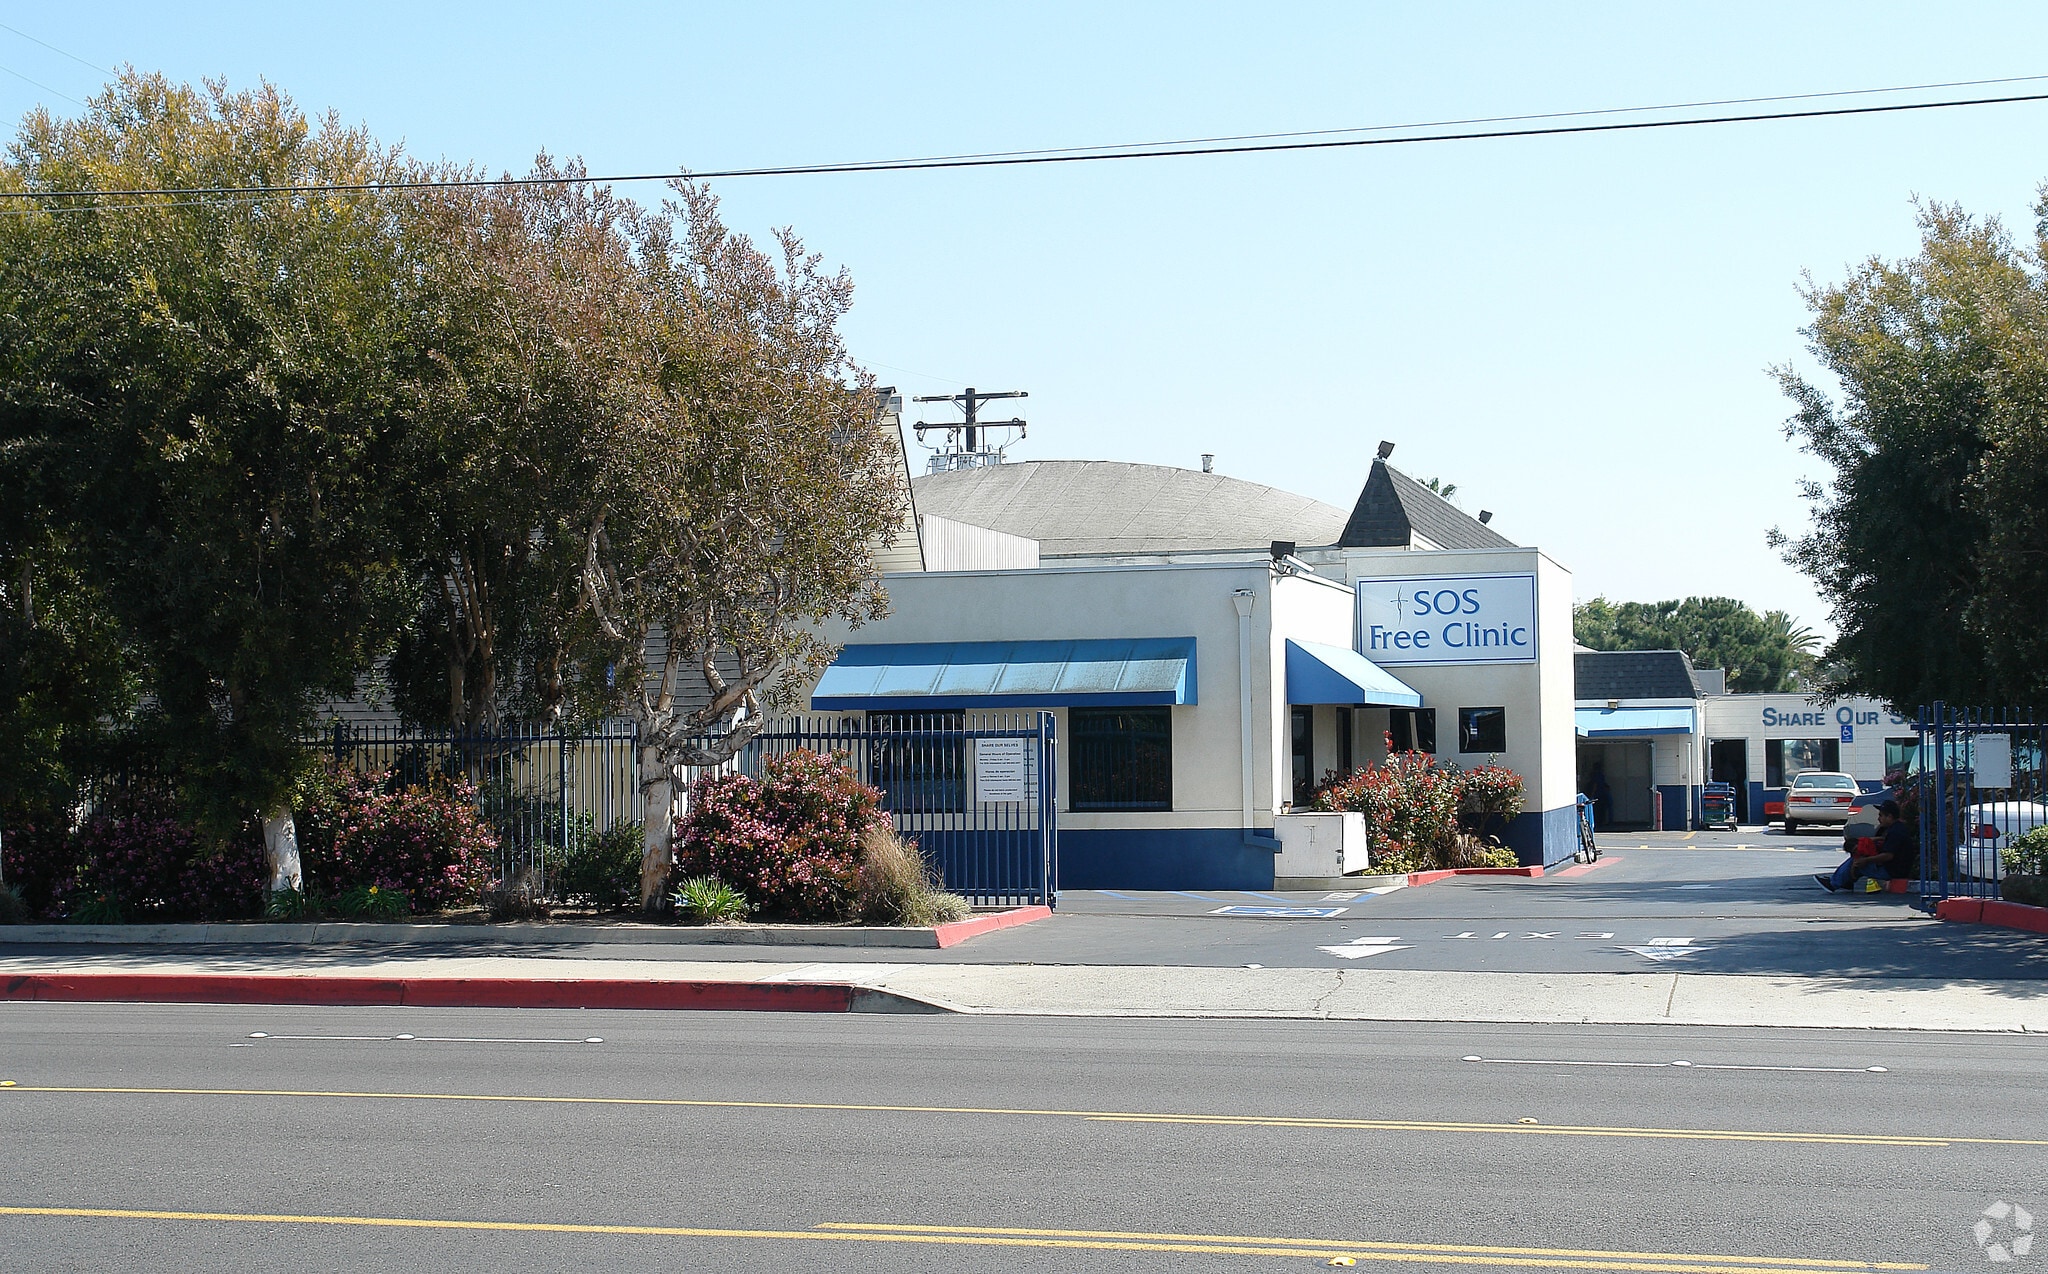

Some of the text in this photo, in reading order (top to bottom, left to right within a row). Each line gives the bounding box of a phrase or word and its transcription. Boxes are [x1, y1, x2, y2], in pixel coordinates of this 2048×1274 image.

[1413, 588, 1480, 616] SOS
[1369, 621, 1527, 650] Free Clinic
[1762, 706, 1825, 727] SHARE
[1835, 705, 1879, 726] OUR
[1442, 931, 1616, 940] EXIT
